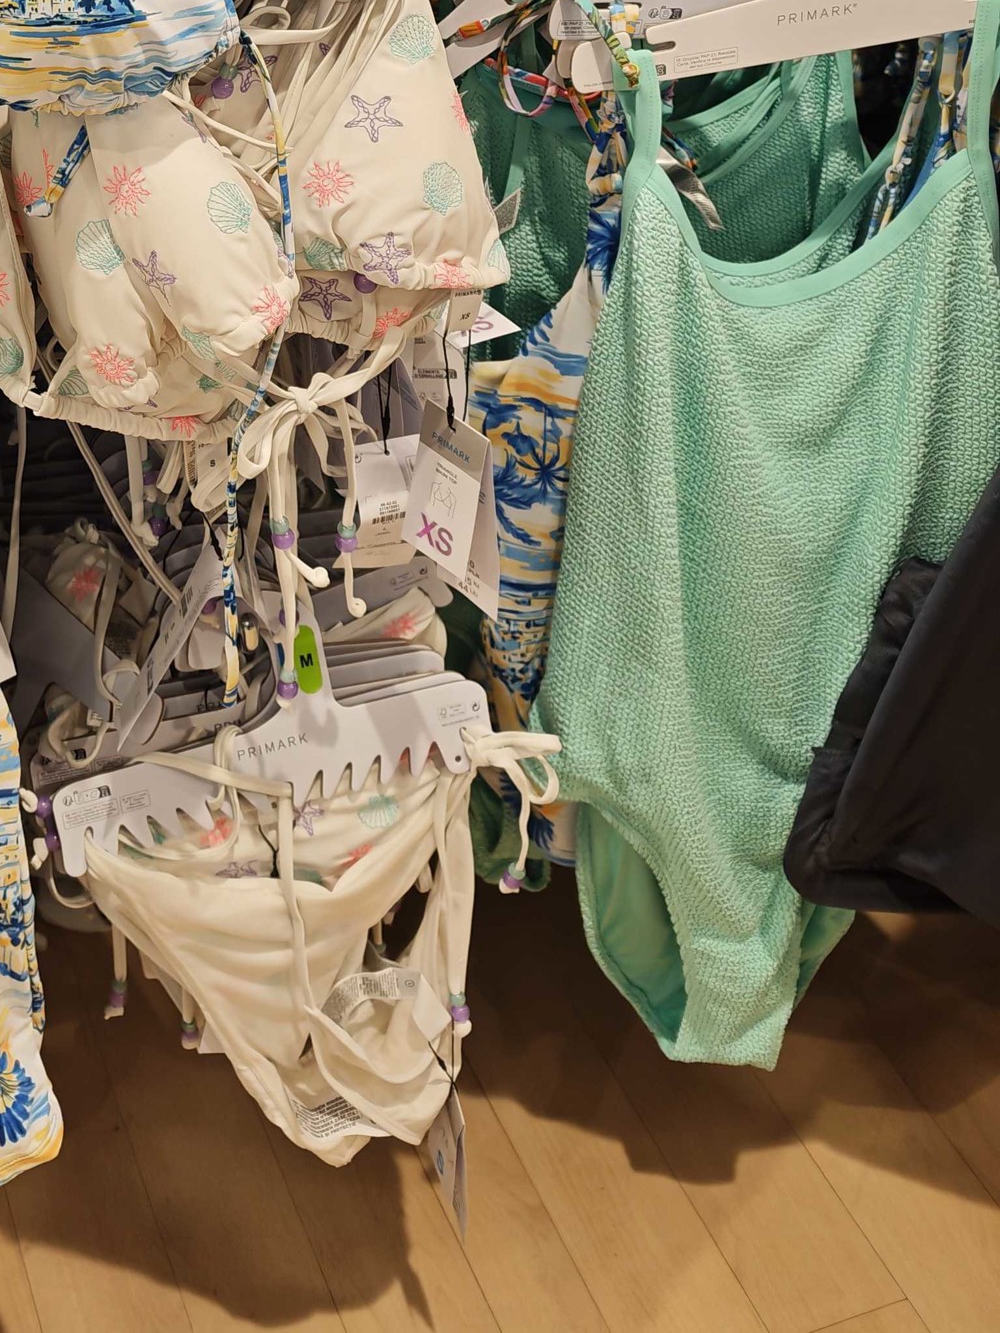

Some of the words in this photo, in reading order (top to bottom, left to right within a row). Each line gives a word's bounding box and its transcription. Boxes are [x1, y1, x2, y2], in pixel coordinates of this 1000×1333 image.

[431, 431, 471, 464] PRIMARK
[209, 459, 216, 468] S
[415, 512, 454, 557] XS
[299, 654, 314, 668] M
[237, 732, 310, 761] PRIMARK
